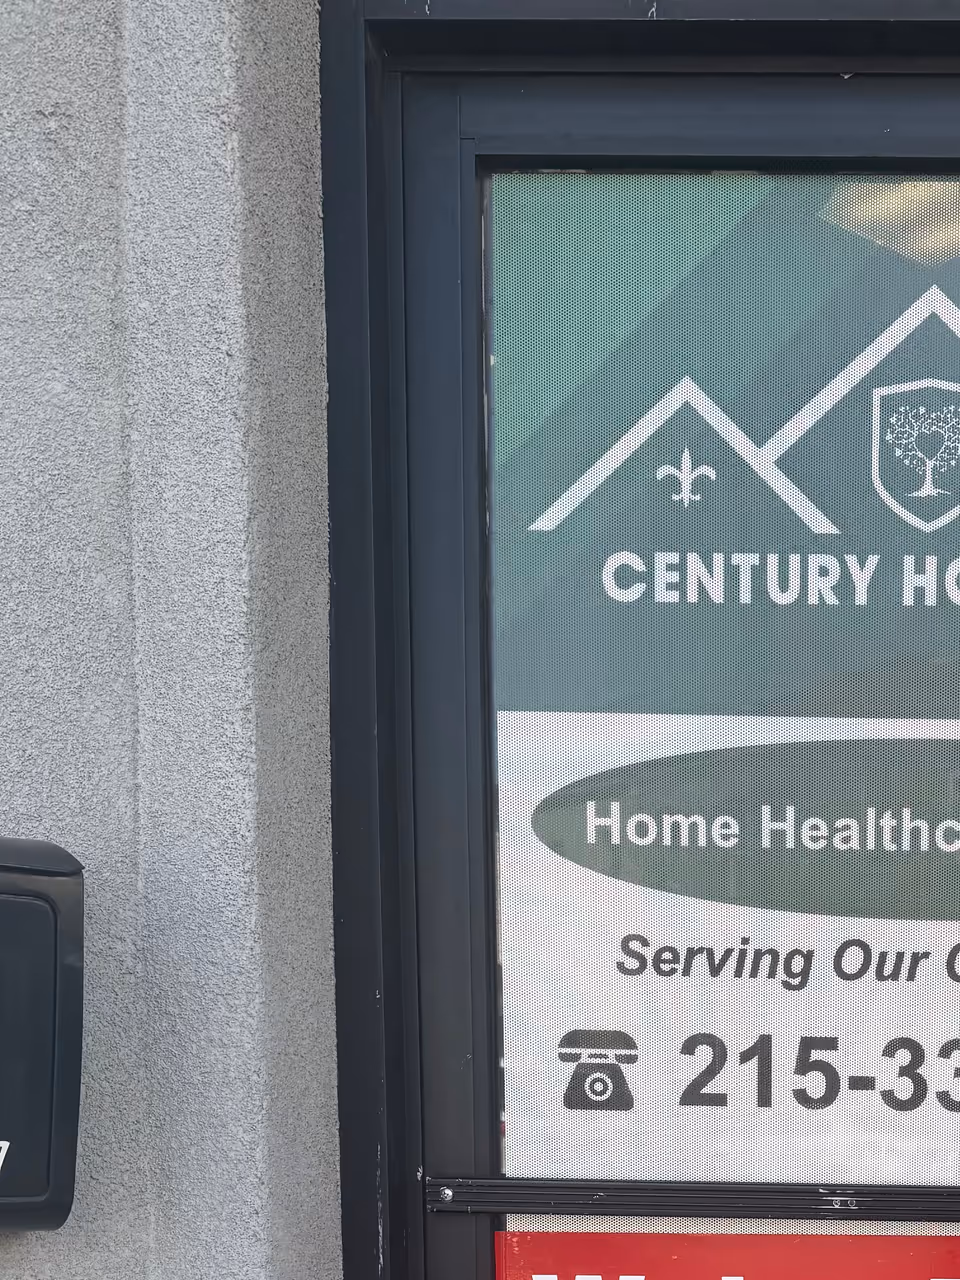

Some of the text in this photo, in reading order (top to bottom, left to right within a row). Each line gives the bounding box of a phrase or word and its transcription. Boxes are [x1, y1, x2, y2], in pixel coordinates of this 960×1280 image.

[602, 551, 879, 605] CENTURY
[586, 801, 739, 848] Home
[617, 934, 814, 991] Serving
[833, 939, 930, 982] Our
